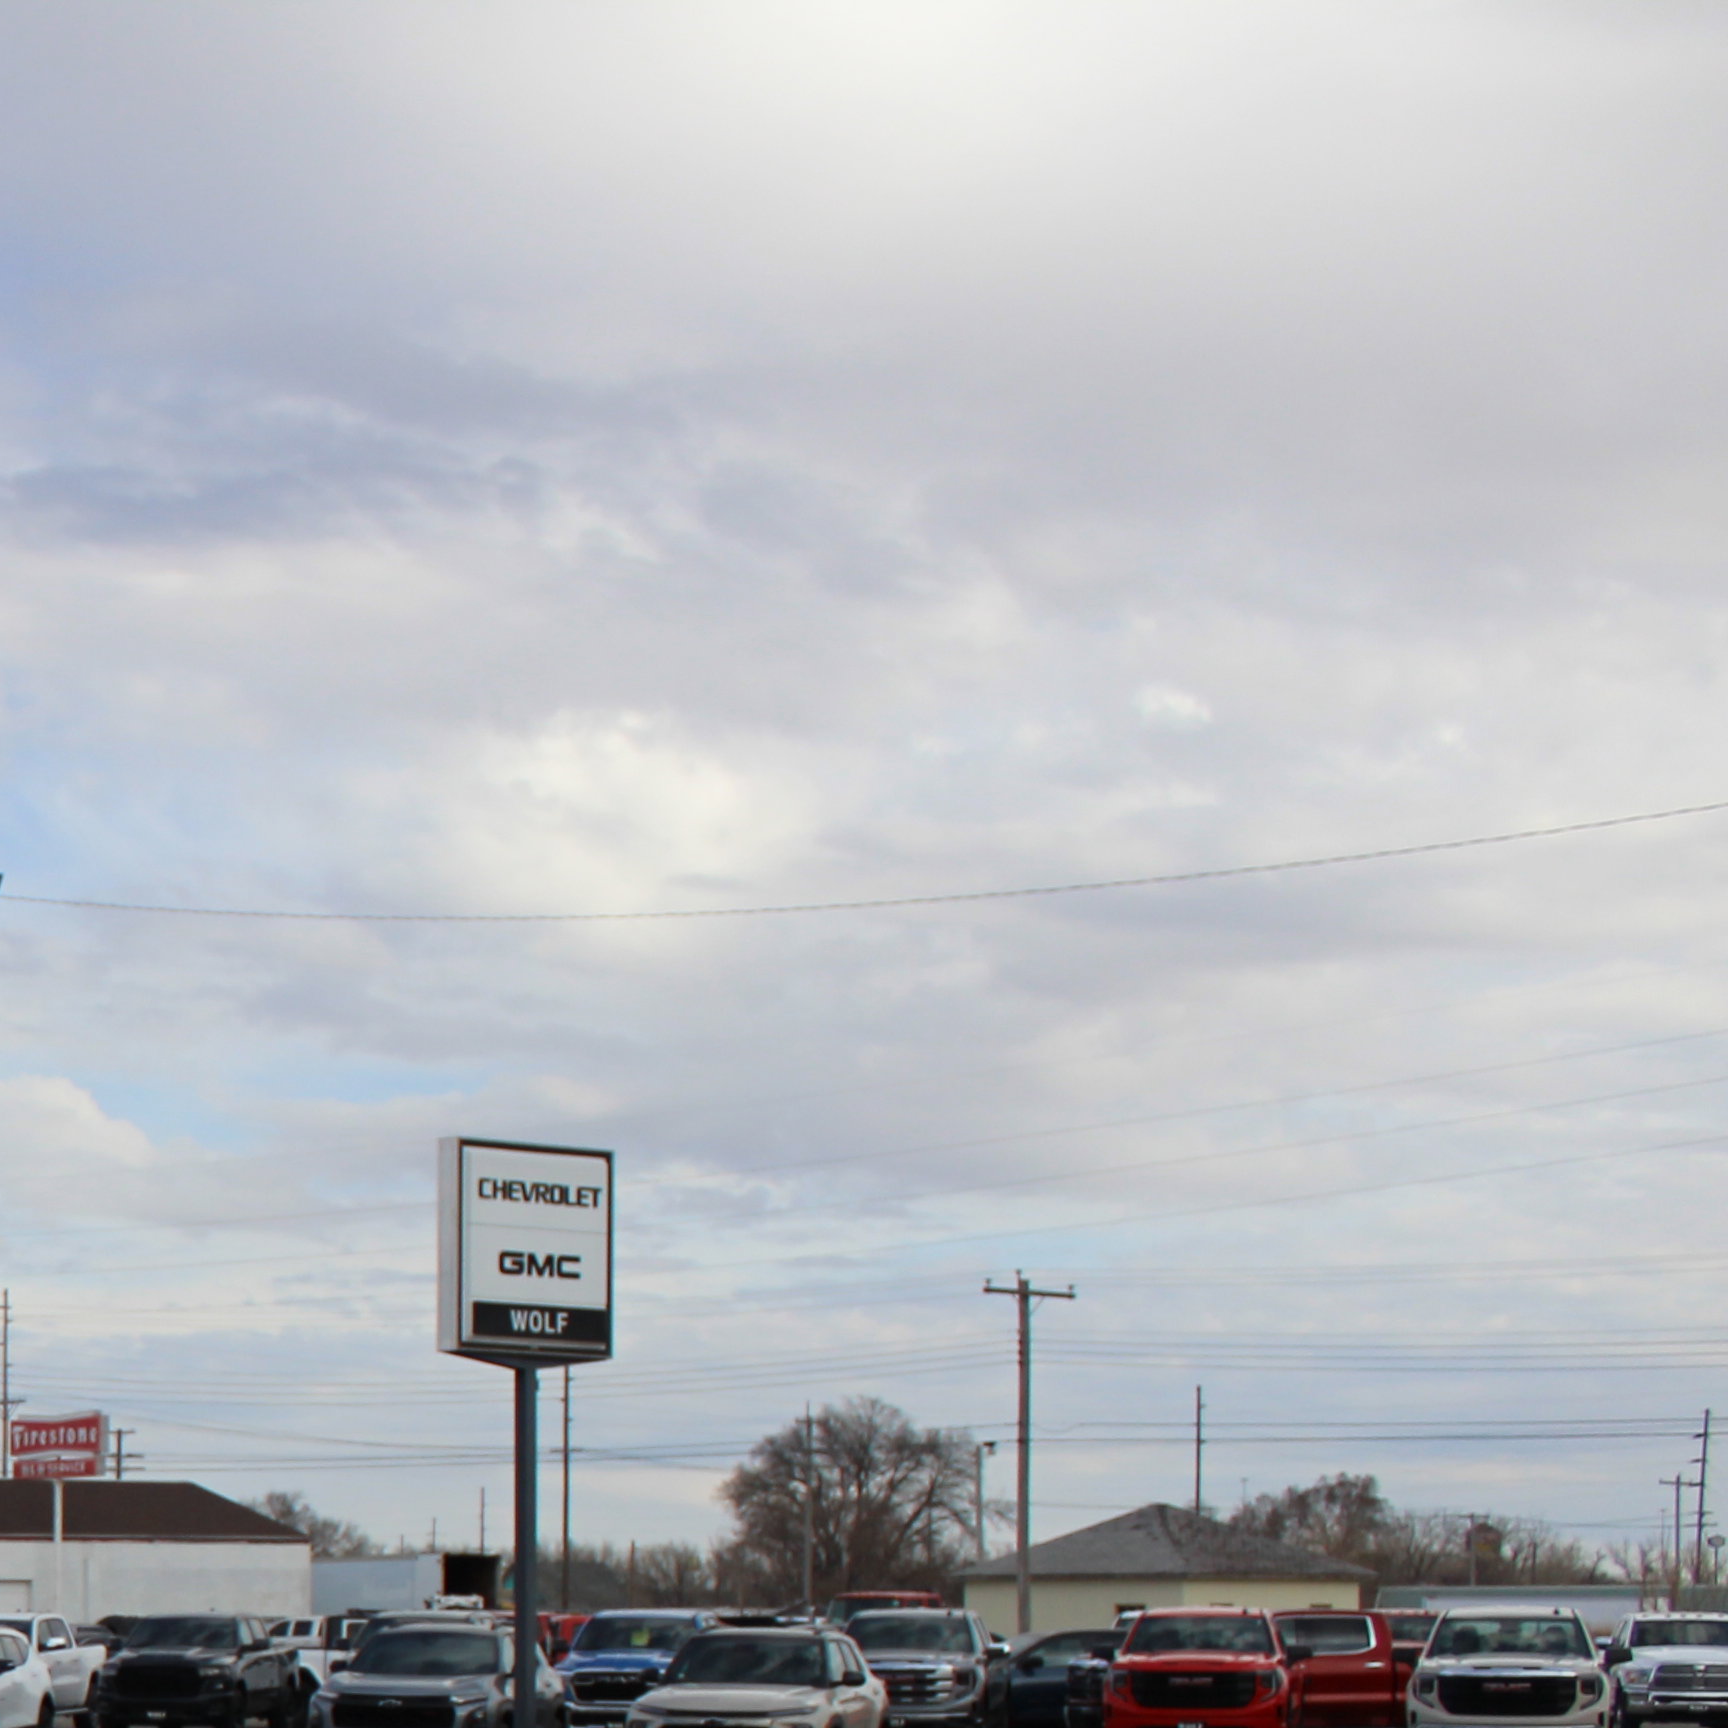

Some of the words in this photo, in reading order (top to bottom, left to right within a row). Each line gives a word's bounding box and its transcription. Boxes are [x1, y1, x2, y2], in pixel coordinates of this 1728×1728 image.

[478, 1177, 603, 1209] CHEVROLET
[499, 1251, 582, 1280] GMC
[510, 1308, 569, 1335] WOLF
[12, 1426, 98, 1450] Firestone
